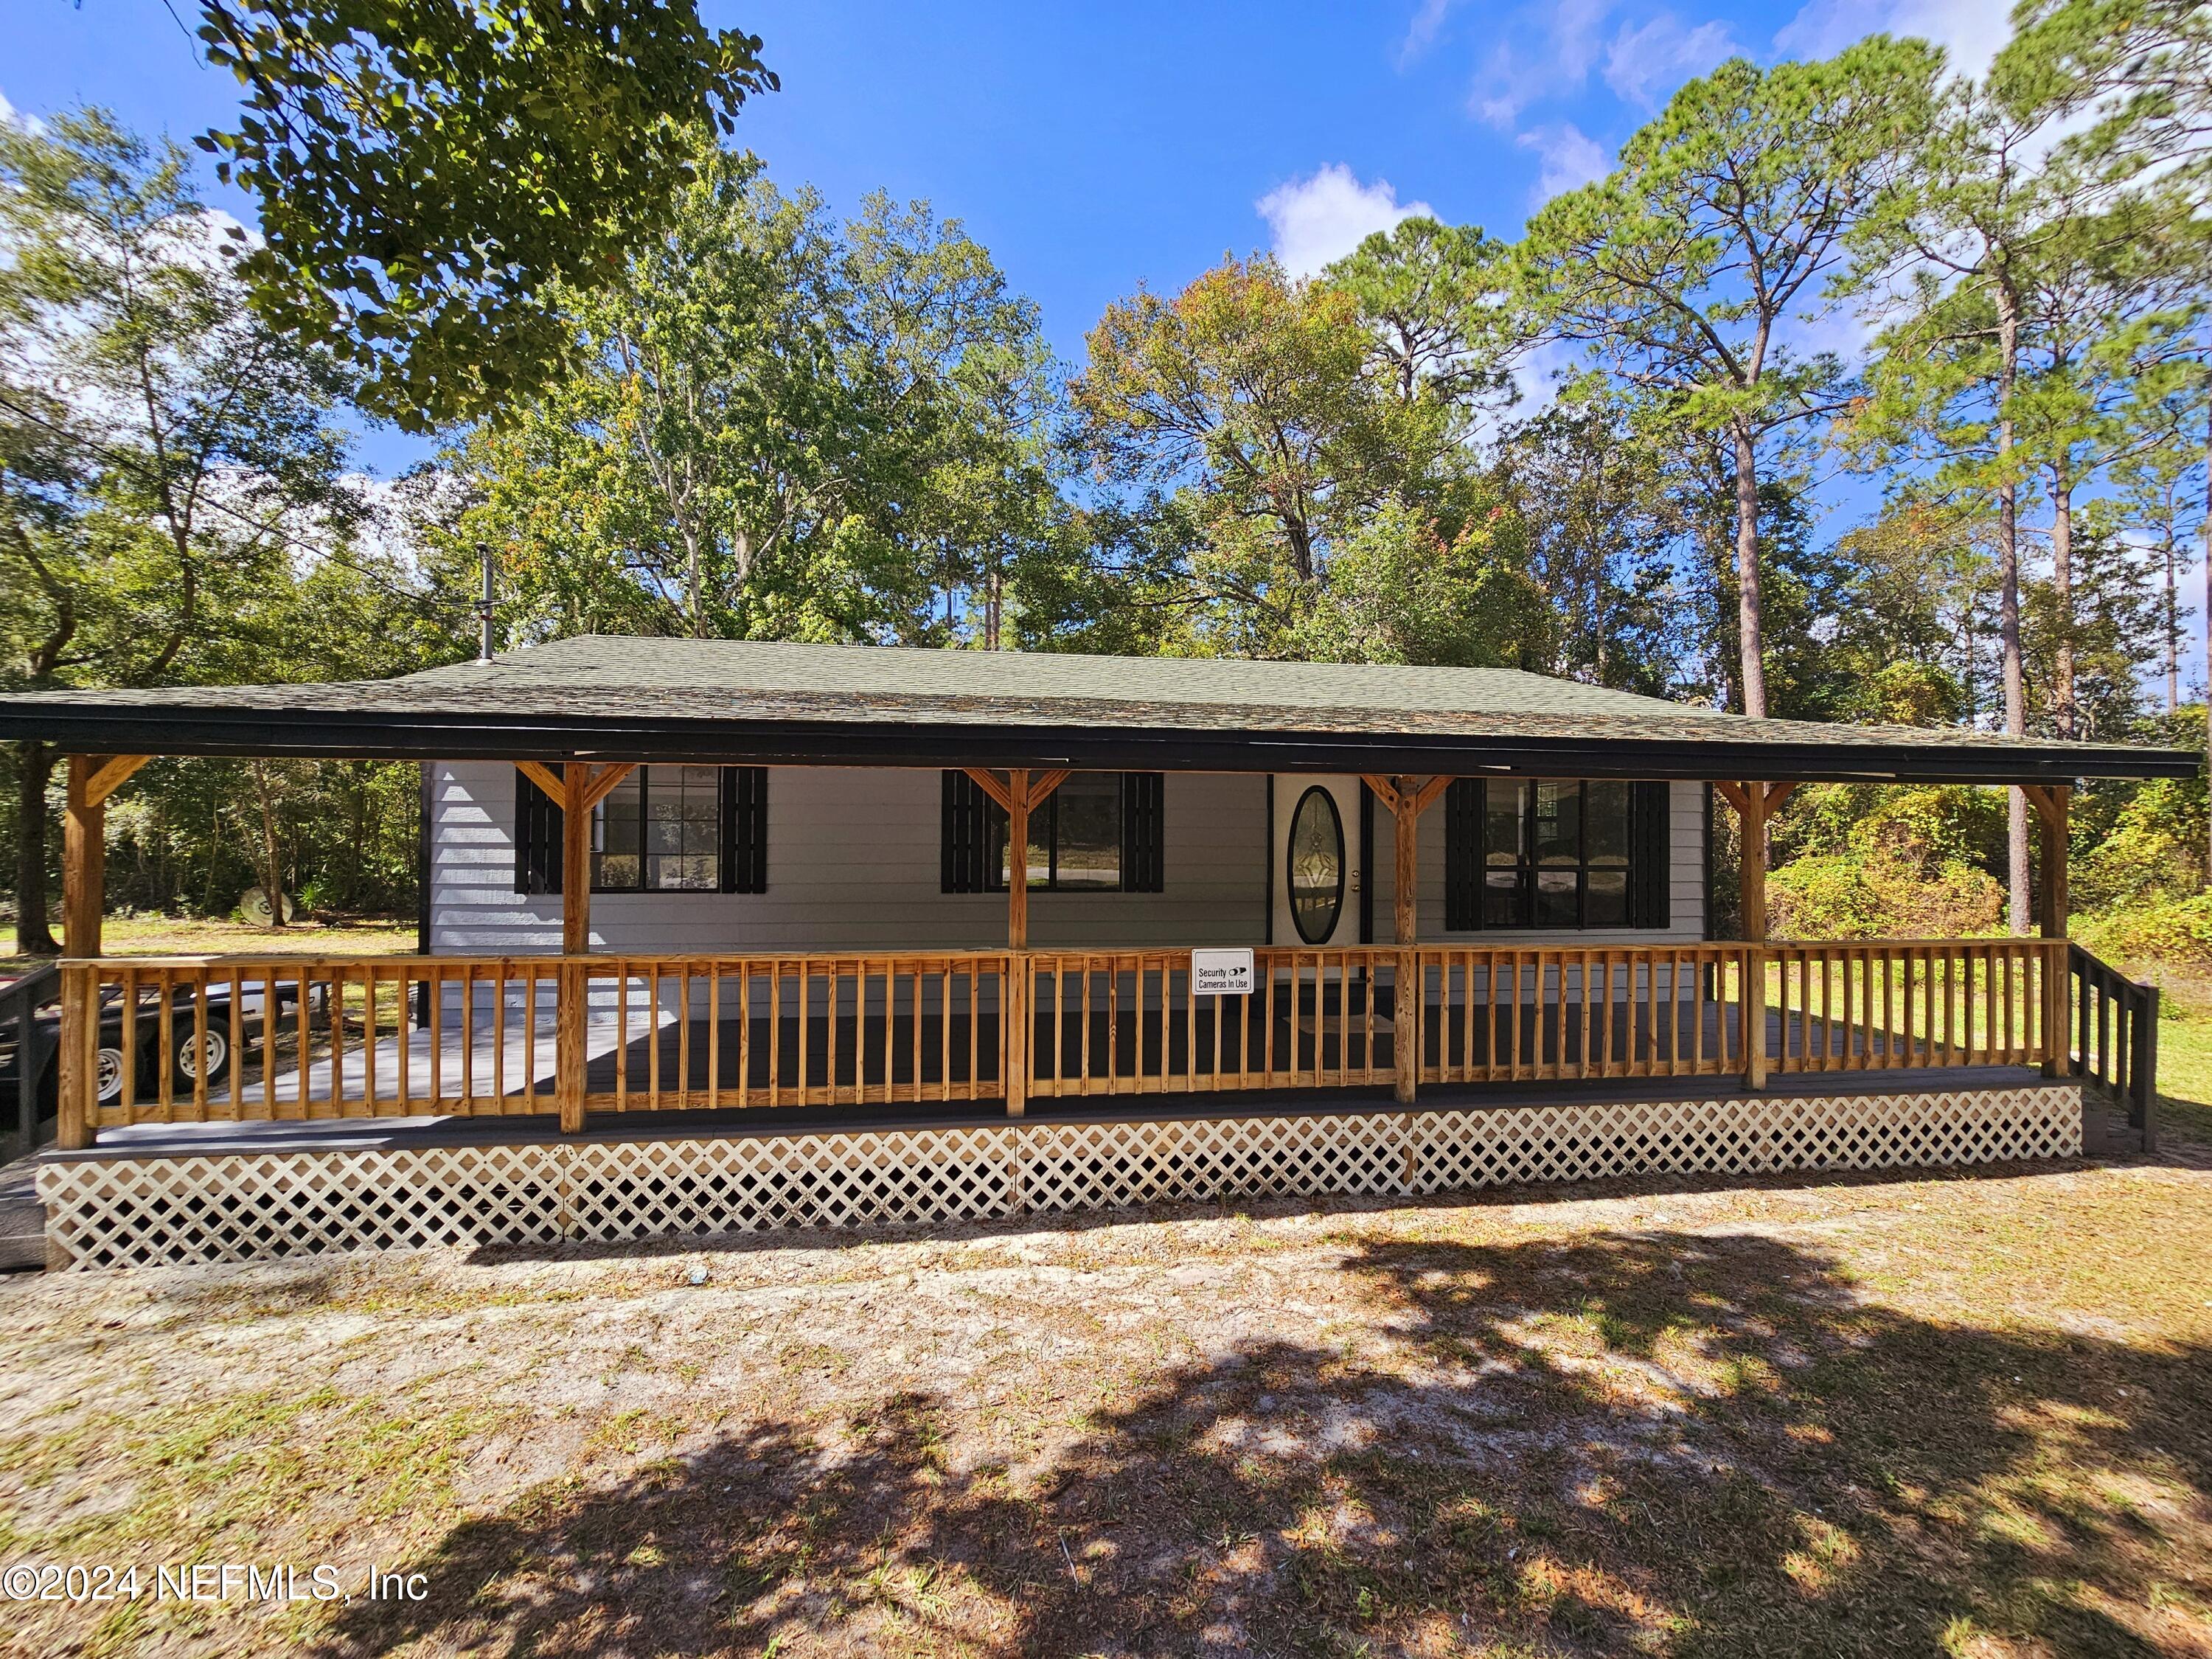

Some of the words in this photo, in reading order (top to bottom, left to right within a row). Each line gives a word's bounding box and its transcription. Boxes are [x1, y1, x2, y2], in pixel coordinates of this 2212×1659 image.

[1199, 968, 1226, 978] Security
[1199, 980, 1226, 989] Cameras
[1228, 980, 1234, 988] In
[1236, 979, 1248, 988] Use
